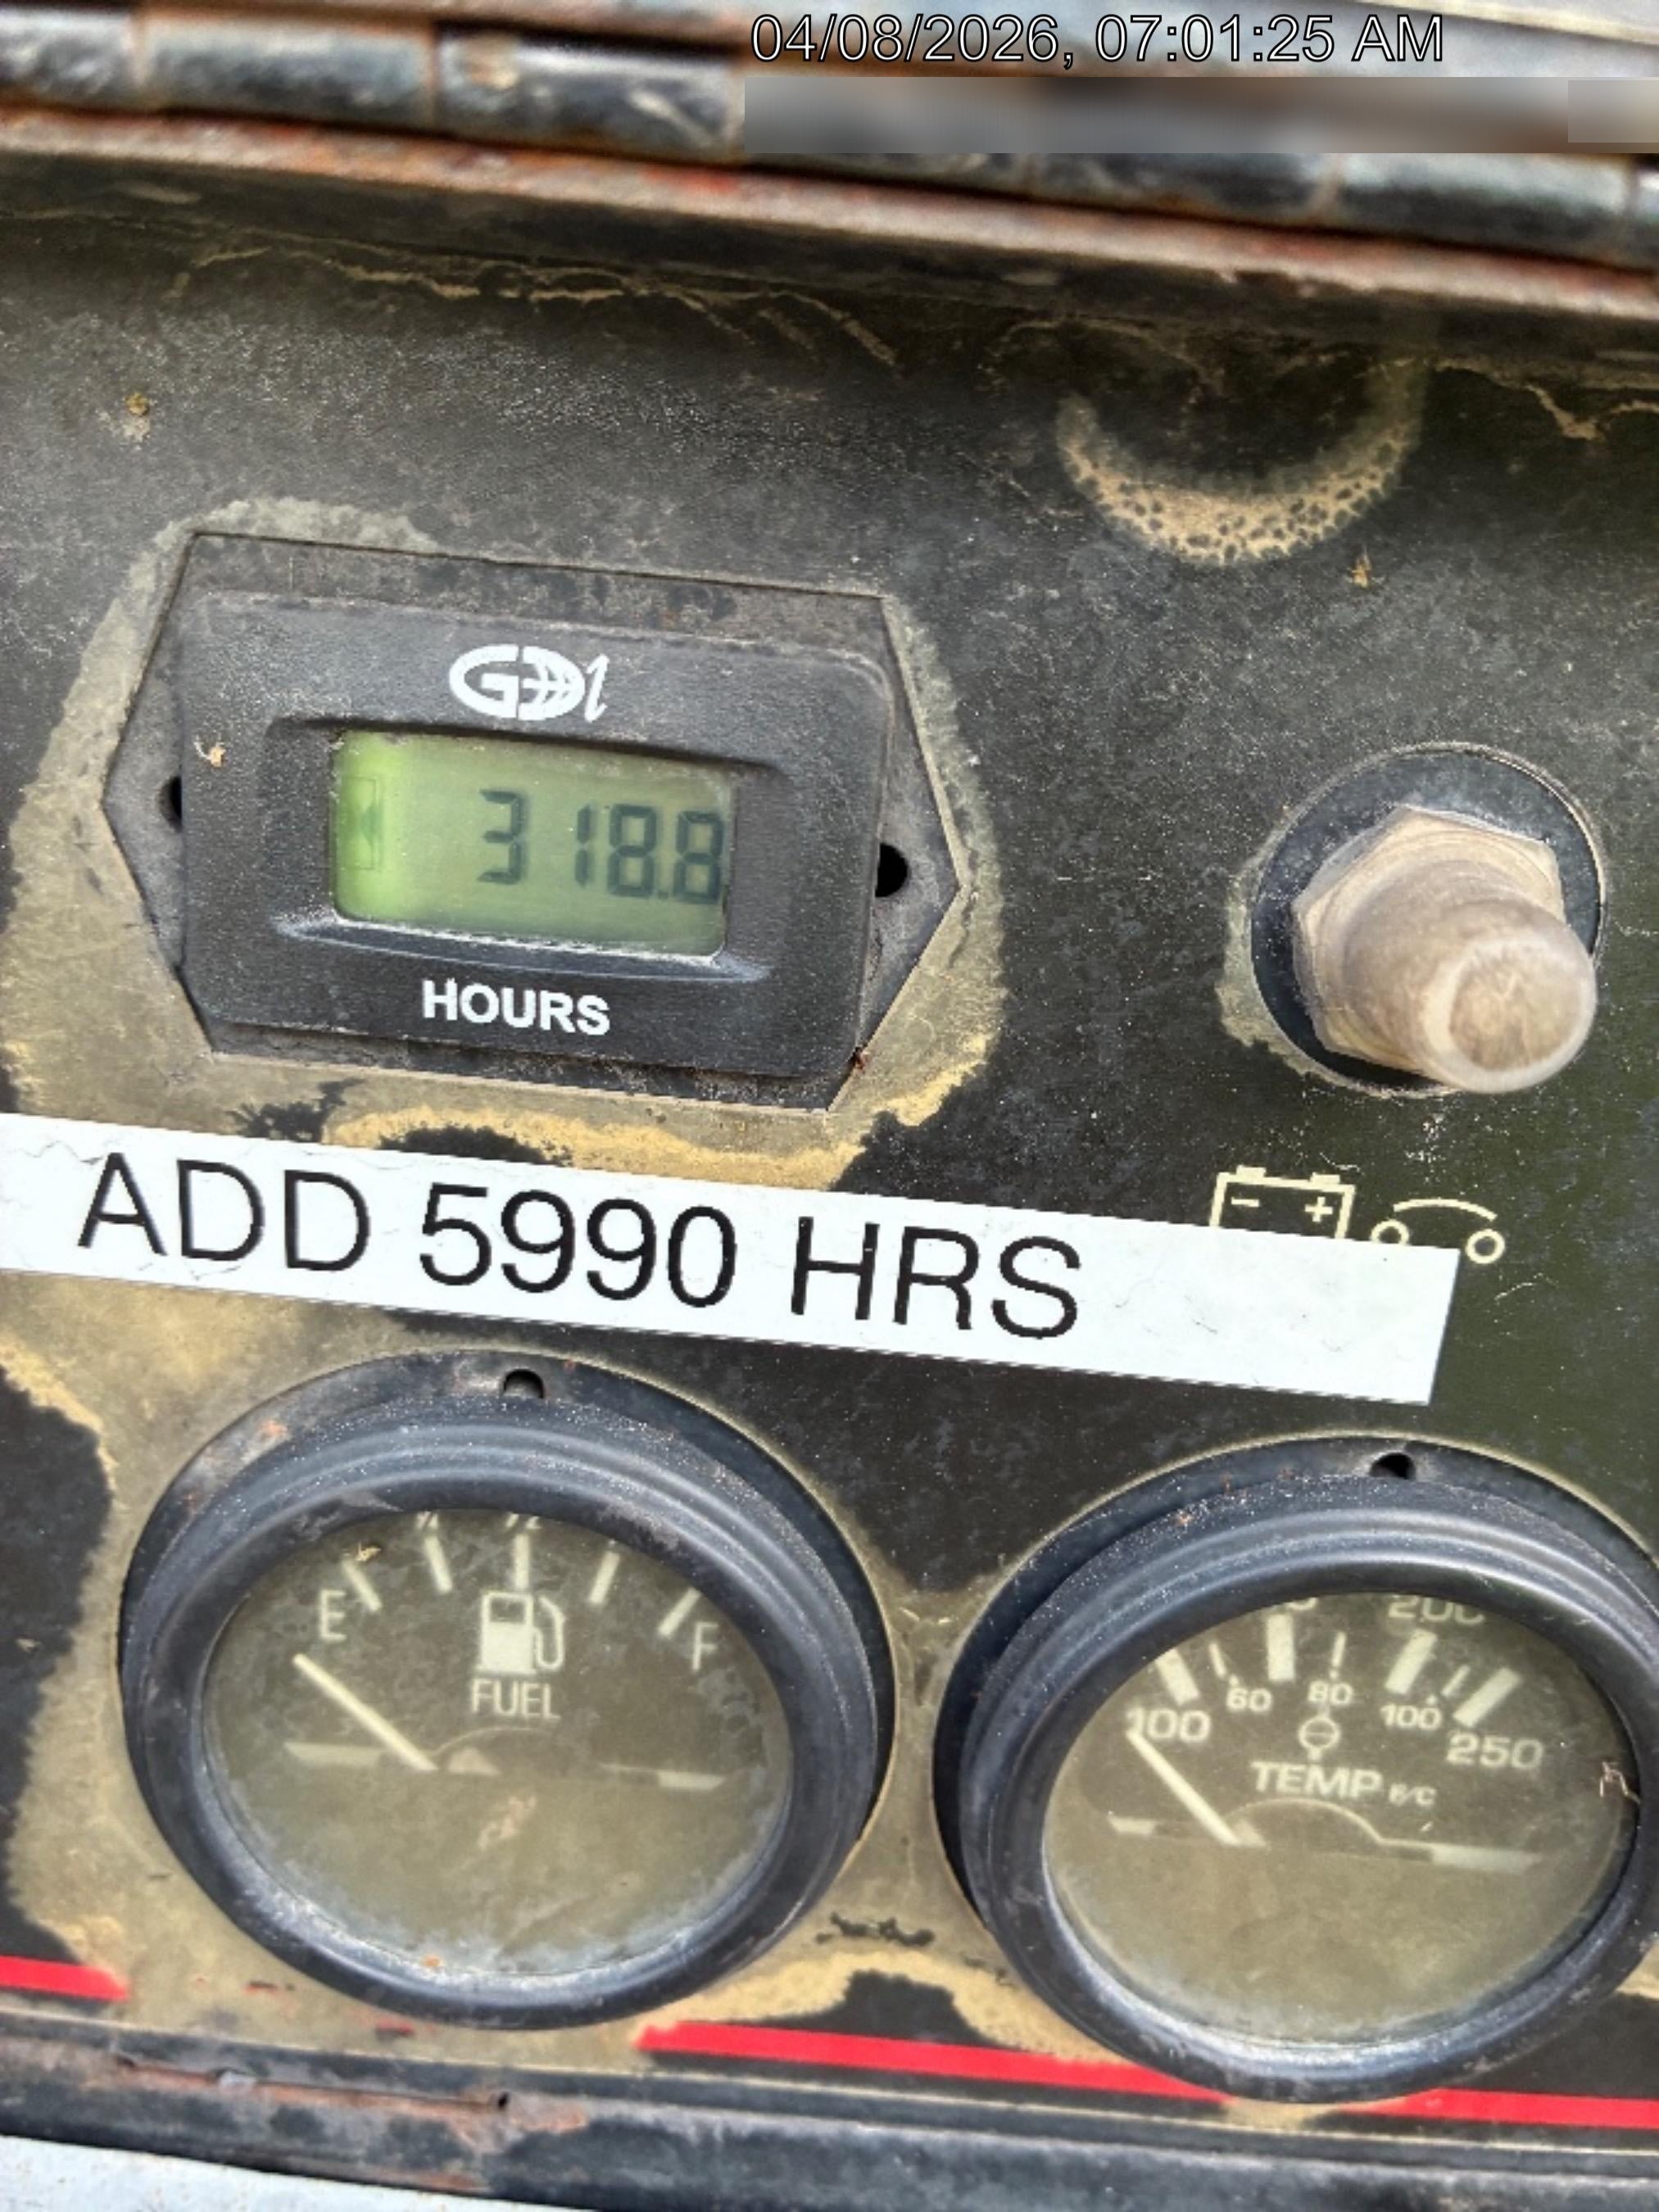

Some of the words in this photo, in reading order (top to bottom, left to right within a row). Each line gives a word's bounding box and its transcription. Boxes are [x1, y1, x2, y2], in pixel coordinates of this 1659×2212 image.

[422, 978, 611, 1036] HOURS
[78, 1152, 371, 1272] ADD
[419, 1182, 738, 1308] 5990
[790, 1216, 1081, 1340] HRS
[319, 1589, 347, 1641] E
[691, 1622, 719, 1672] F
[469, 1679, 560, 1720] FUEL
[1225, 1684, 1273, 1714] 60
[1306, 1680, 1353, 1707] 80
[1126, 1705, 1213, 1744] 100
[1380, 1704, 1441, 1732] 100
[1445, 1732, 1544, 1771] 250
[1249, 1759, 1384, 1800] TEMP
